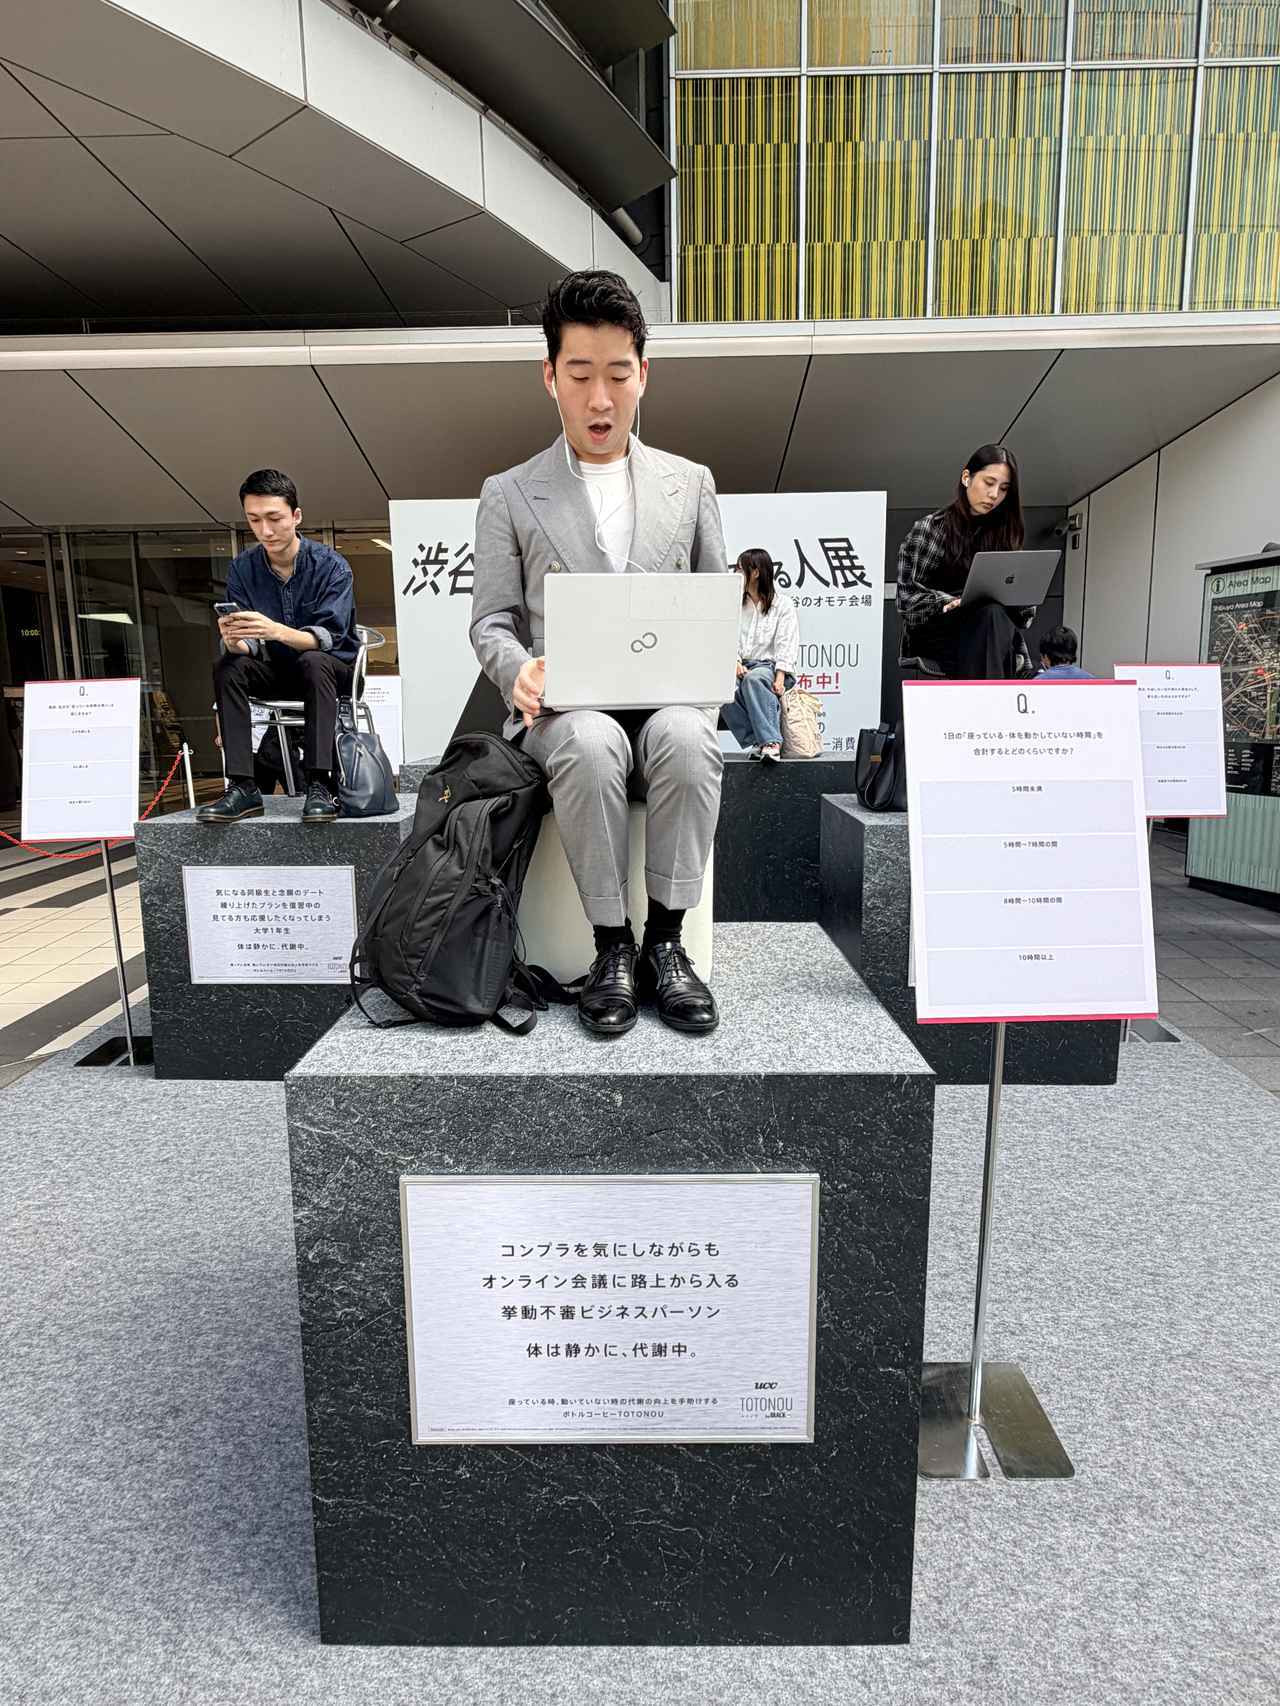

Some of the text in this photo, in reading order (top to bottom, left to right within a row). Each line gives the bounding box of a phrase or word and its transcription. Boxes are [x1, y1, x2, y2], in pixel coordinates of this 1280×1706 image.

[1228, 576, 1272, 588] Area Map
[1017, 693, 1036, 714] Q.
[501, 1241, 720, 1258] コンプラを気にしながらも
[482, 1273, 740, 1290] オンライン会議に路上から入る
[501, 1304, 721, 1321] 挙動不審ビジネスパーソン
[526, 1342, 697, 1358] 体は静かに、代謝中。
[740, 1397, 793, 1412] TOTONOU
